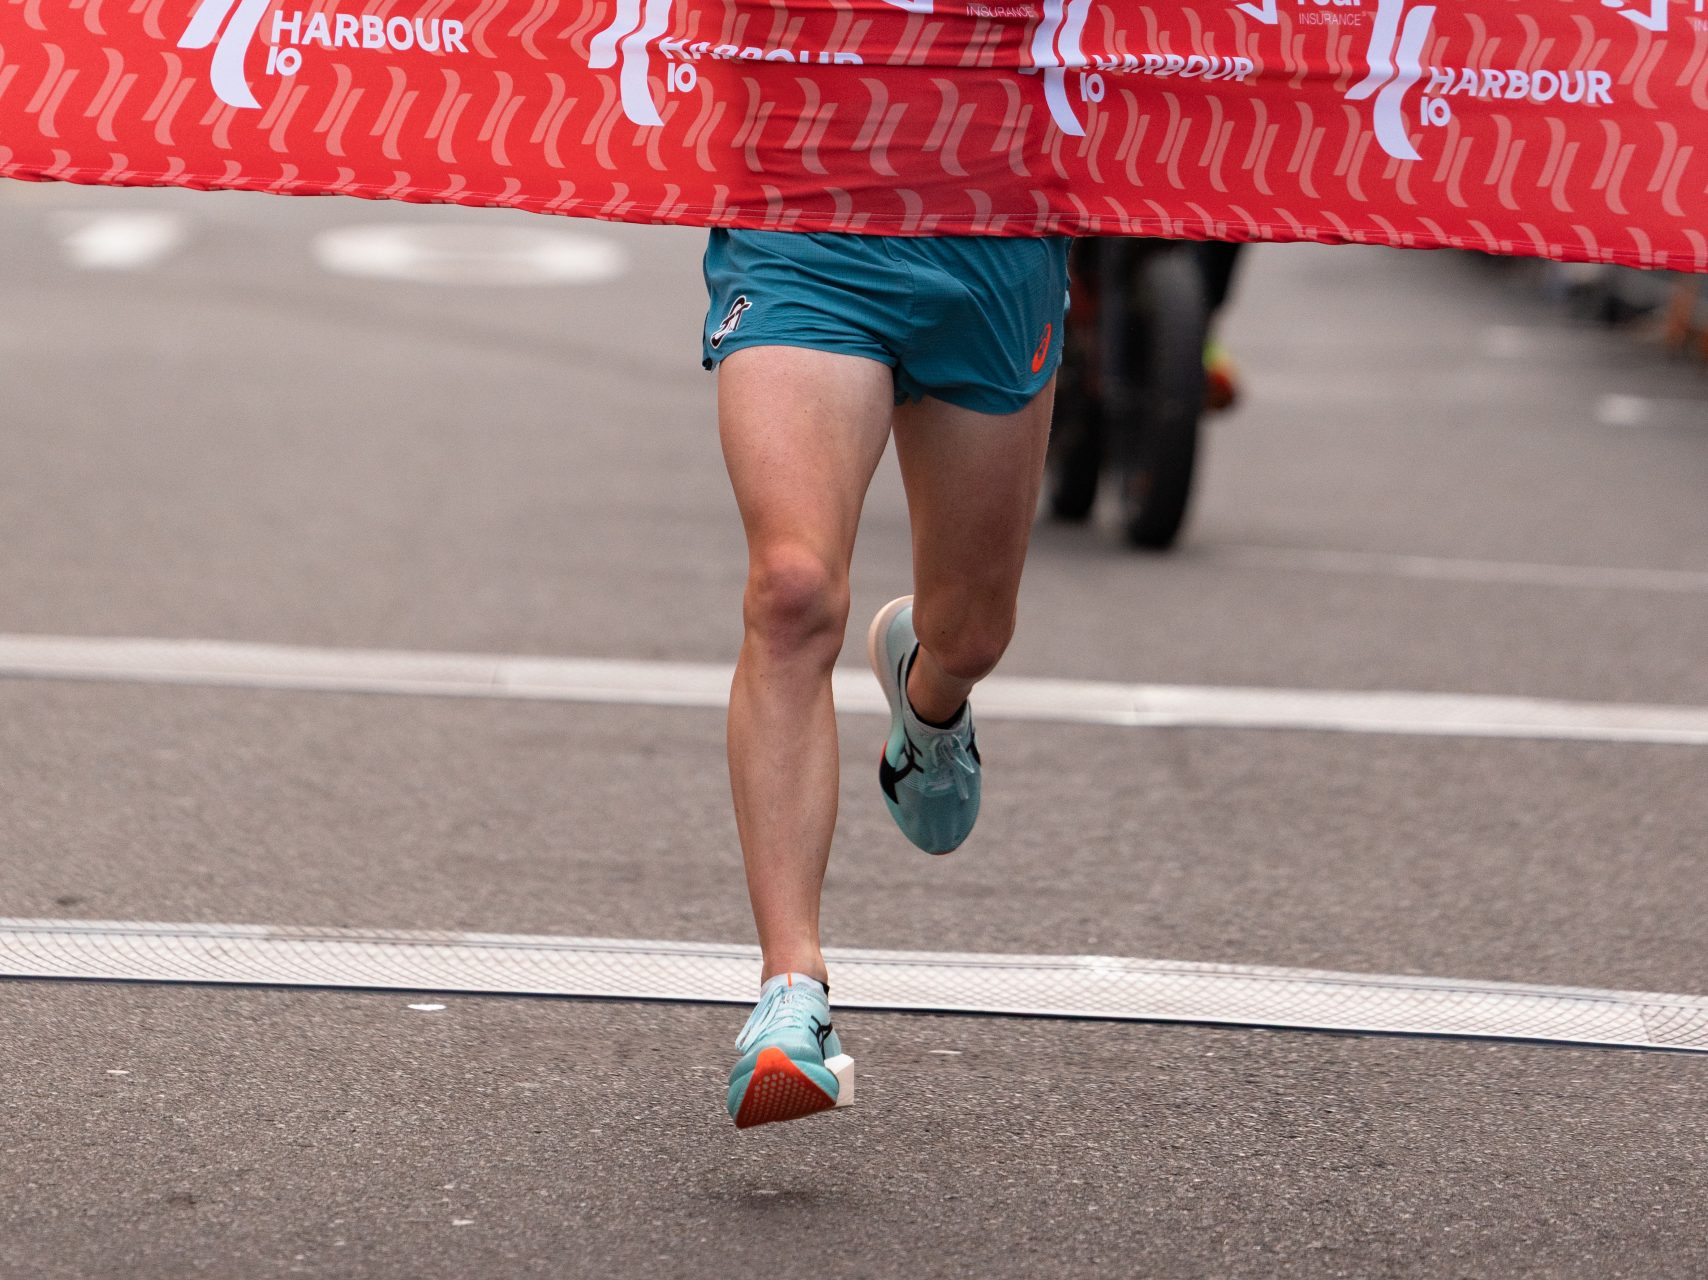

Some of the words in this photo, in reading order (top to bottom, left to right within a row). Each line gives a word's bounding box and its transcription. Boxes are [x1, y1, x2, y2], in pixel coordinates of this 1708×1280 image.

[966, 5, 1034, 18] INSURANCE
[1298, 12, 1361, 26] INSURANCE
[270, 9, 470, 53] HARBOUR
[1091, 53, 1254, 82] HARBOUR
[1423, 66, 1614, 104] HARBOUR
